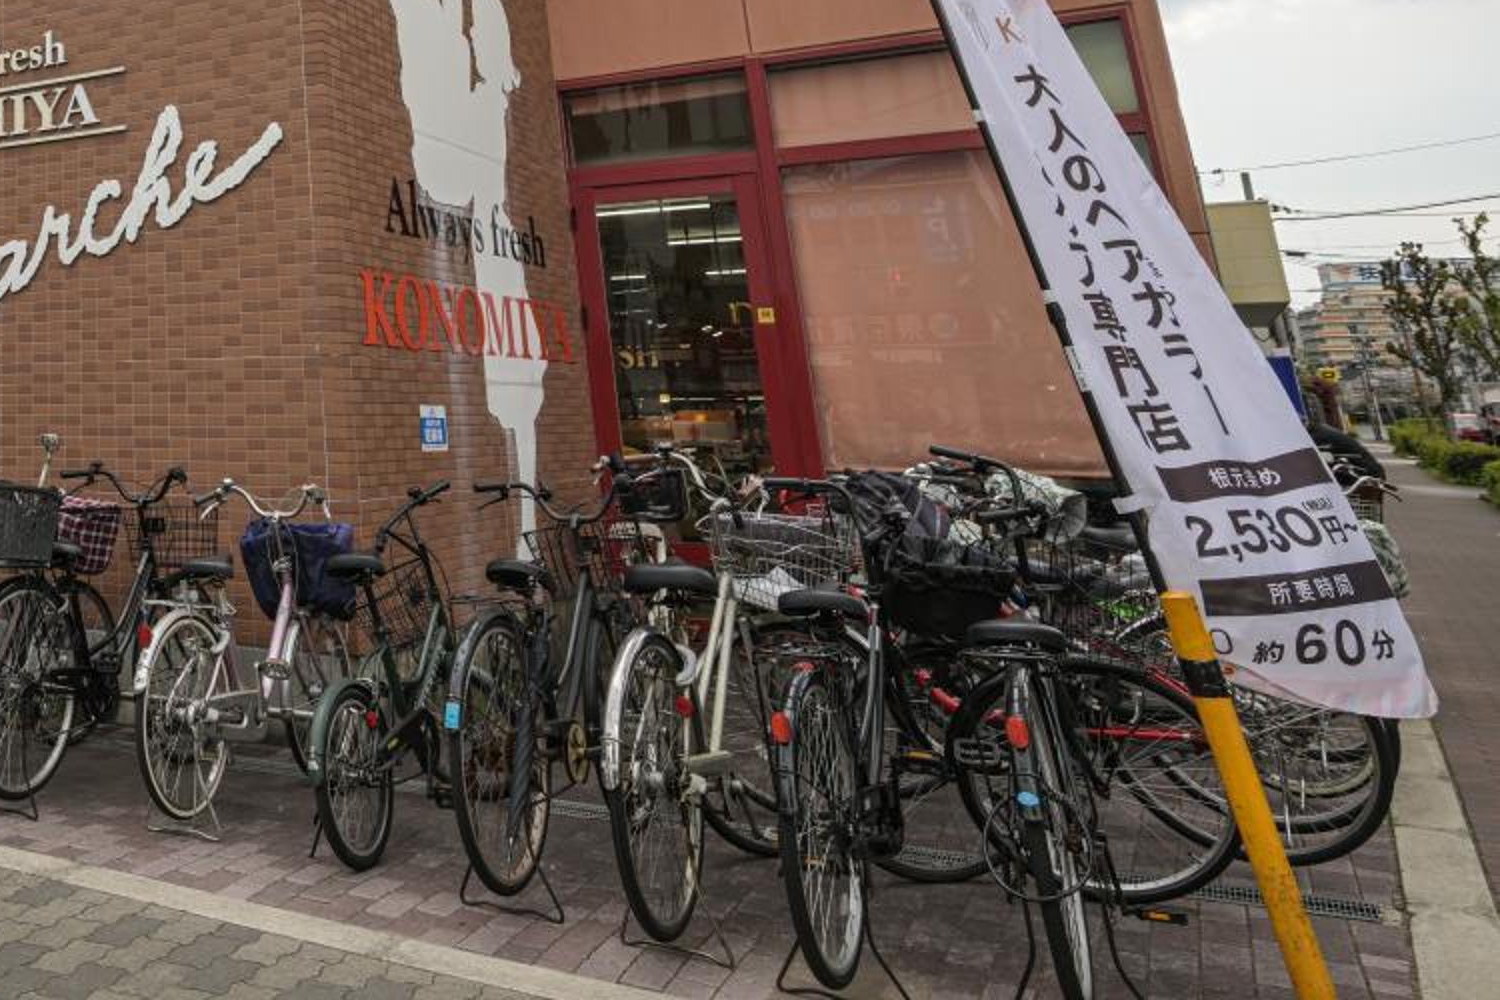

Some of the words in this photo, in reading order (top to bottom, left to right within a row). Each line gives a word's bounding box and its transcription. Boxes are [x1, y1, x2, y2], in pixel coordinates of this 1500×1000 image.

[384, 177, 485, 265] Always
[491, 204, 547, 268] fresh
[360, 266, 575, 362] KONOMIYA
[1267, 573, 1355, 606] 所要時間
